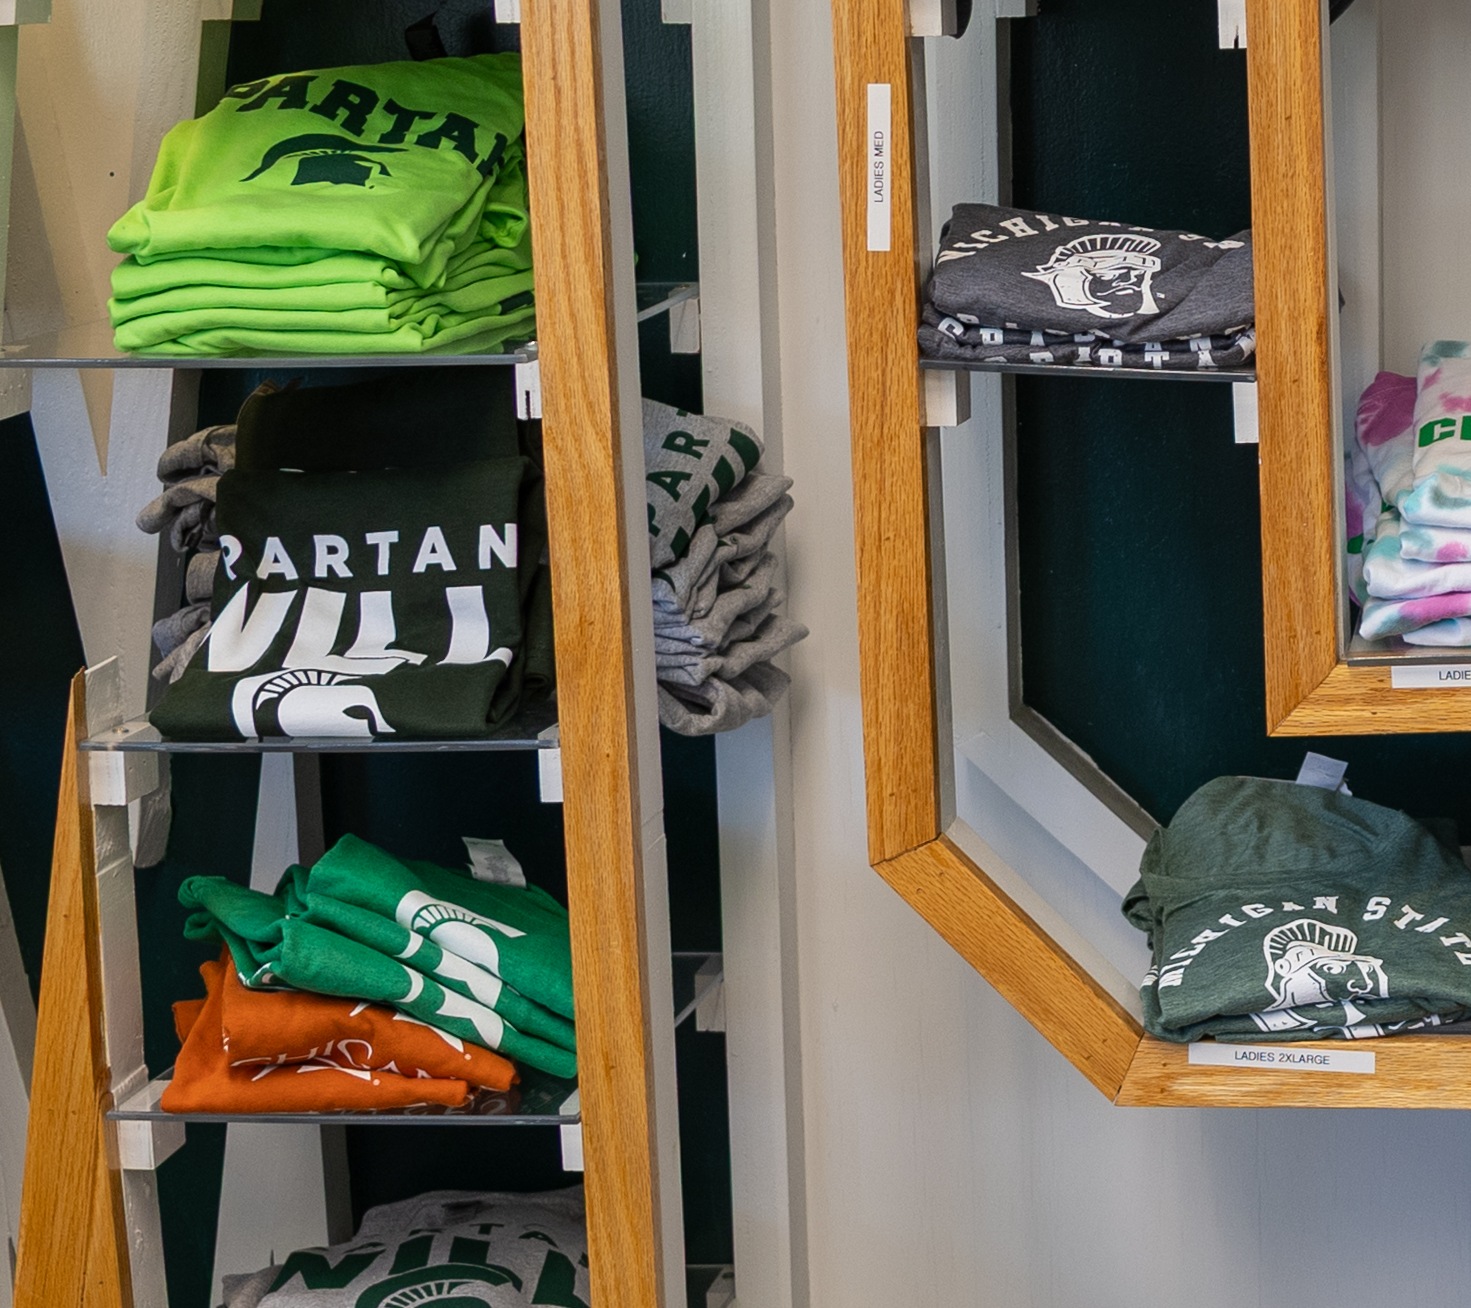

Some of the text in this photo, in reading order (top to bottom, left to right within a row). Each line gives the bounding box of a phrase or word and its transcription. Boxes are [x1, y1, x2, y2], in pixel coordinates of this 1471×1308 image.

[873, 129, 885, 203] LADIES MED
[1234, 1050, 1330, 1066] LADIES 2XLARGE
